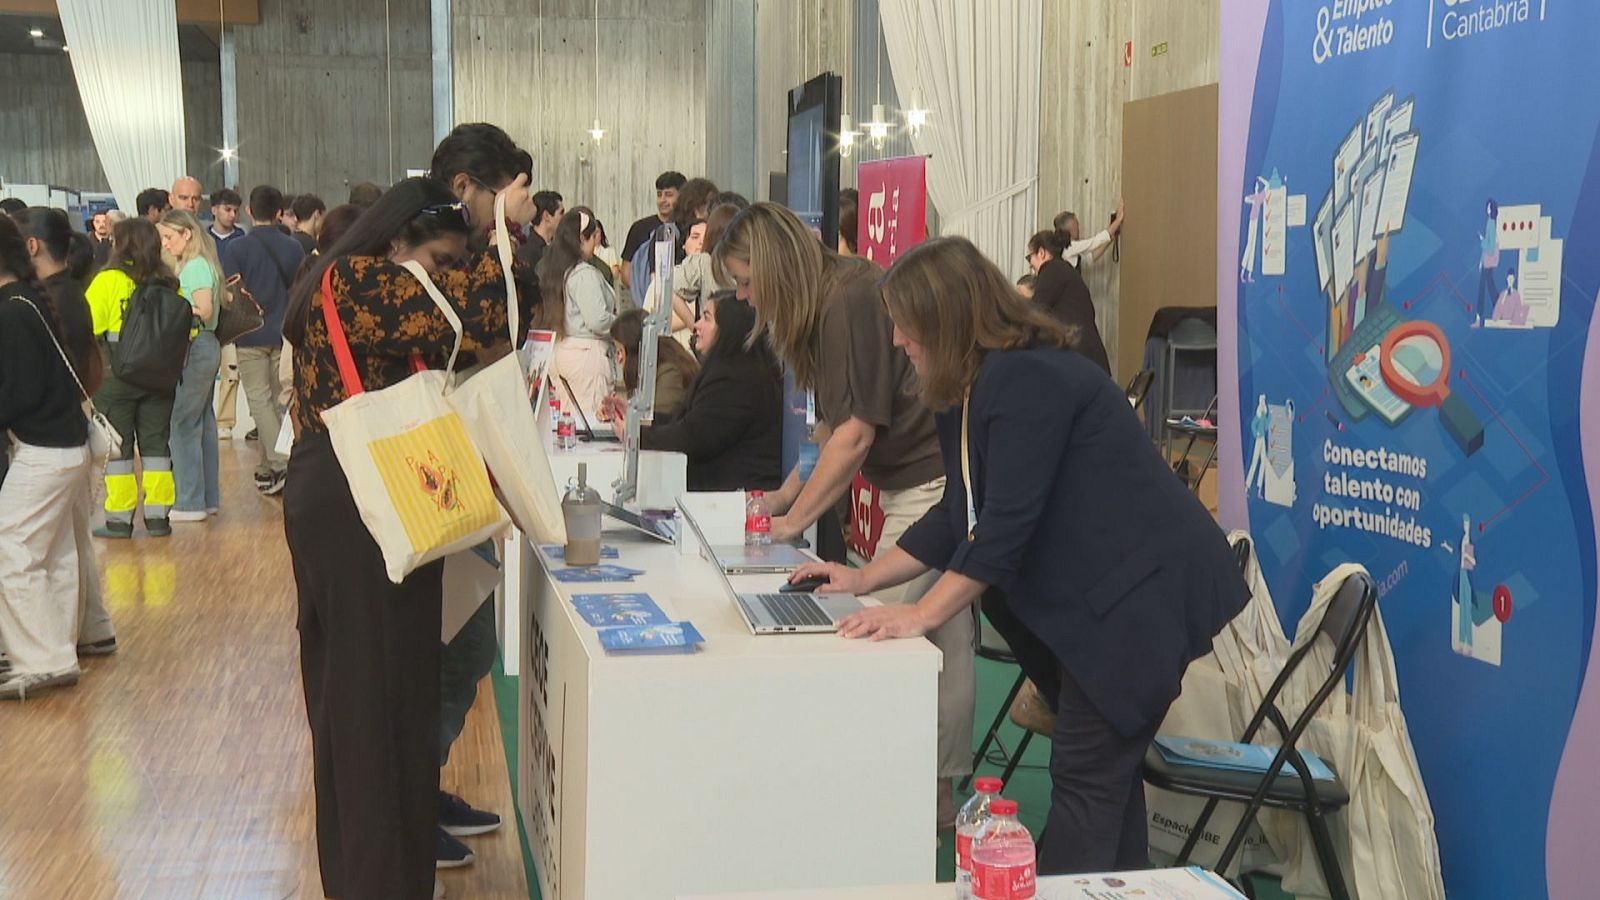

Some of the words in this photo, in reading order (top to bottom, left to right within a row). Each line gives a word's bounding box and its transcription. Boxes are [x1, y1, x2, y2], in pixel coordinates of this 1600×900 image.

[1312, 6, 1334, 64] &
[1336, 16, 1393, 55] Talento
[1442, 0, 1529, 40] Cantabria
[1323, 438, 1427, 479] Conectamos
[1324, 471, 1393, 503] talento
[1396, 485, 1420, 511] con
[1312, 503, 1431, 548] oportunidades
[1377, 560, 1408, 600] ia.com
[1500, 595, 1505, 613] 1
